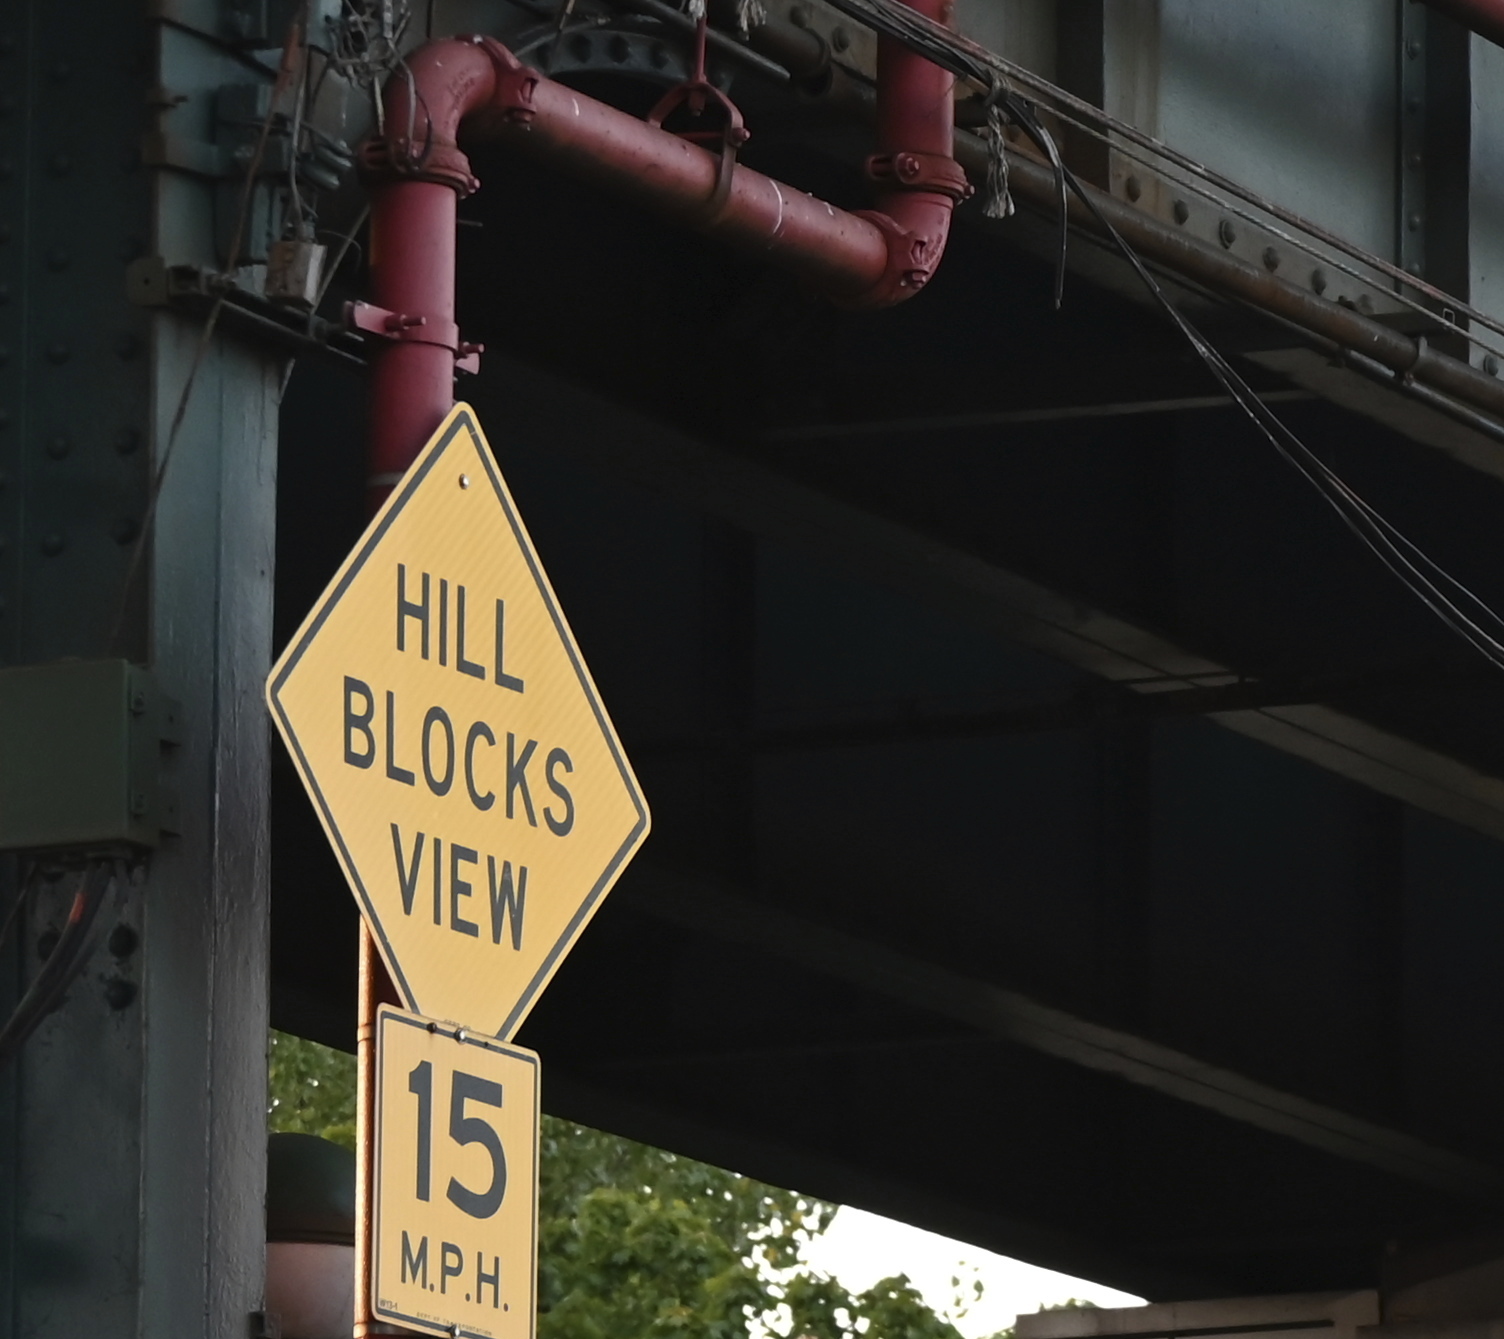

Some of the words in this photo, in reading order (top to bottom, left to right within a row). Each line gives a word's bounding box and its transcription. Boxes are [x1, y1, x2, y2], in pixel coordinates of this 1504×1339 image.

[395, 562, 526, 693] HILL
[343, 675, 575, 837] BLOCKS
[389, 822, 528, 951] VIEW
[407, 1060, 508, 1220] 15
[400, 1232, 510, 1312] M.P.H.
